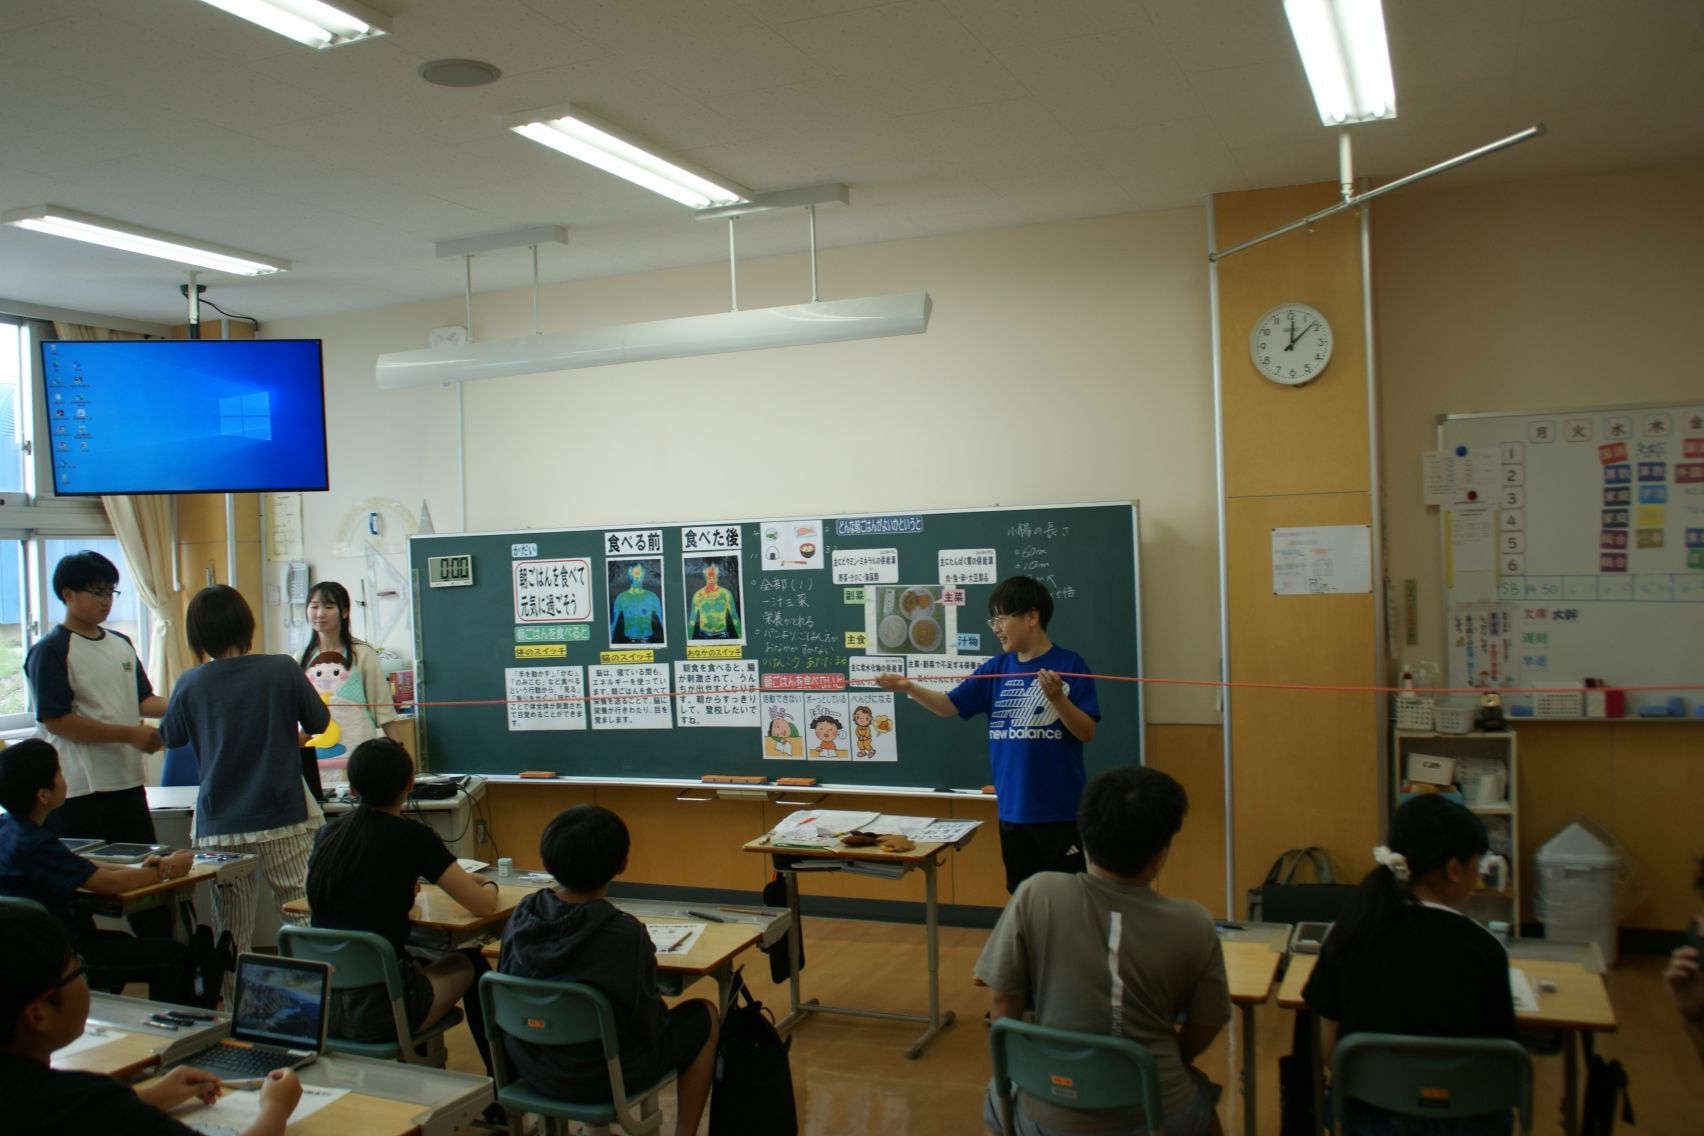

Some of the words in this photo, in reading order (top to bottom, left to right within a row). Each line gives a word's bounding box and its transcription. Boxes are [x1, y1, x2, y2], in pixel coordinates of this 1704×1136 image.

[1287, 312, 1295, 320] 12
[1263, 328, 1271, 336] 10
[1318, 338, 1324, 346] 3
[1264, 356, 1270, 364] 8
[1304, 364, 1311, 373] 5
[1610, 423, 1625, 436] 水
[1648, 419, 1664, 432] 木
[1536, 426, 1547, 439] 月
[1571, 425, 1586, 438] 火
[1507, 470, 1517, 482] 2
[1507, 492, 1517, 505] 3
[838, 517, 922, 534] どんな朝ごはんがよいかというと
[1507, 515, 1517, 527] 4
[1007, 521, 1070, 539] 小腸の長さ
[607, 532, 661, 553] 食べる前
[685, 527, 740, 549] 食べた後
[1507, 537, 1518, 549] 5
[513, 545, 536, 556] かだい
[940, 556, 993, 567] 主にたんぱく質の供給源
[1507, 559, 1518, 571] 6
[519, 564, 585, 589] 朝ごはんを食べて
[846, 590, 865, 600] 副菜
[944, 592, 963, 603] 主菜
[521, 593, 577, 617] 元気に過ごそう
[1523, 607, 1547, 619] 欠席
[517, 626, 588, 640] 朝ごはんを食べると
[847, 635, 866, 645] 主食
[958, 636, 978, 647] 汁物
[516, 646, 566, 656] 体のスイッチ
[687, 647, 742, 657] おなかのスイッチ
[601, 652, 654, 662] 脳のスイッチ
[596, 668, 662, 677] 脳は、寝ている間も、
[683, 663, 756, 672] 朝食を食べると、腸
[592, 678, 666, 686] エネルギーを使ってい
[679, 673, 756, 683] が刺激されて、うん
[680, 695, 756, 704] す。朝からすっきり
[763, 695, 802, 703] 活動できない
[851, 695, 892, 703] べんぴになる
[681, 705, 757, 714] して、登校したいで
[512, 719, 521, 727] す。
[594, 716, 633, 724] 覚まします。
[681, 716, 700, 725] すね。
[989, 729, 1008, 739] new
[1008, 727, 1063, 739] balance
